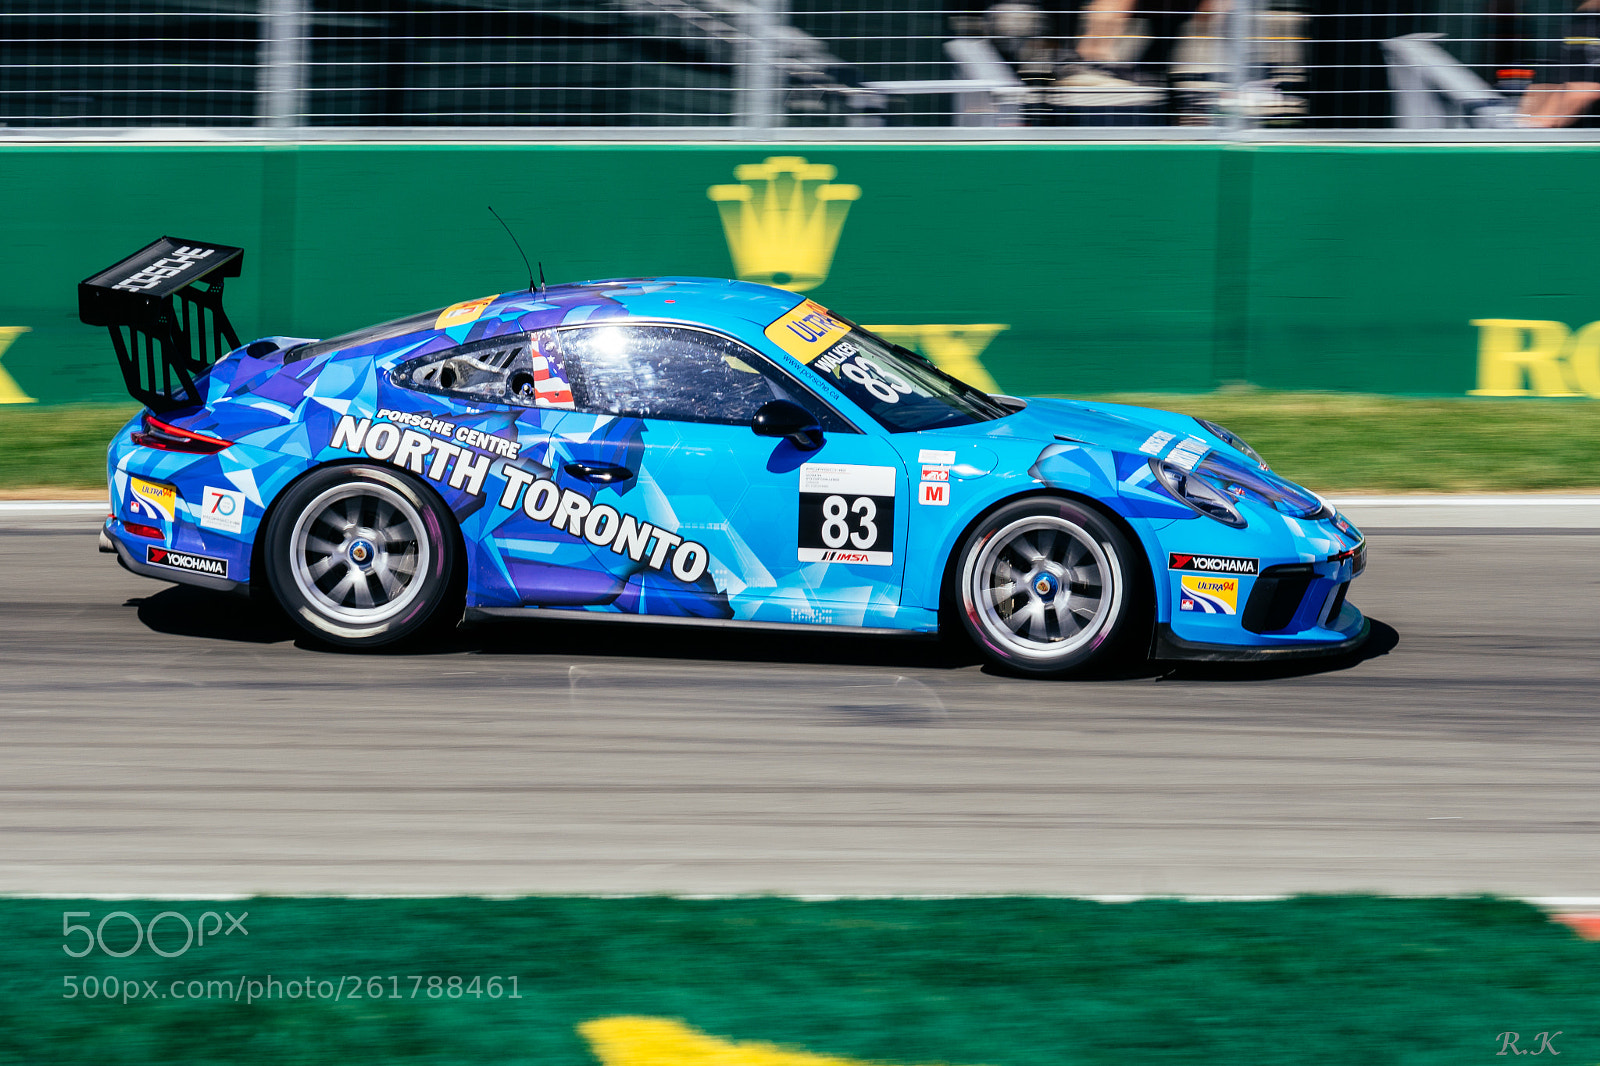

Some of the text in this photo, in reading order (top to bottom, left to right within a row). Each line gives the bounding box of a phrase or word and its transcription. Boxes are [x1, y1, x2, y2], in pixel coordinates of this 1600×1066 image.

[111, 246, 215, 292] ORSCHE
[783, 354, 840, 401] www.porsche.ca
[814, 341, 859, 374] WALKER
[841, 356, 913, 404] 83
[375, 408, 521, 460] PORSCHE CENTRE
[330, 414, 710, 584] NORTH TORONTO
[926, 486, 943, 501] M
[821, 494, 878, 550] 83
[167, 552, 224, 574] YOKOHAMA
[836, 553, 869, 562] IMSA
[1192, 556, 1255, 573] YOKOHAMA
